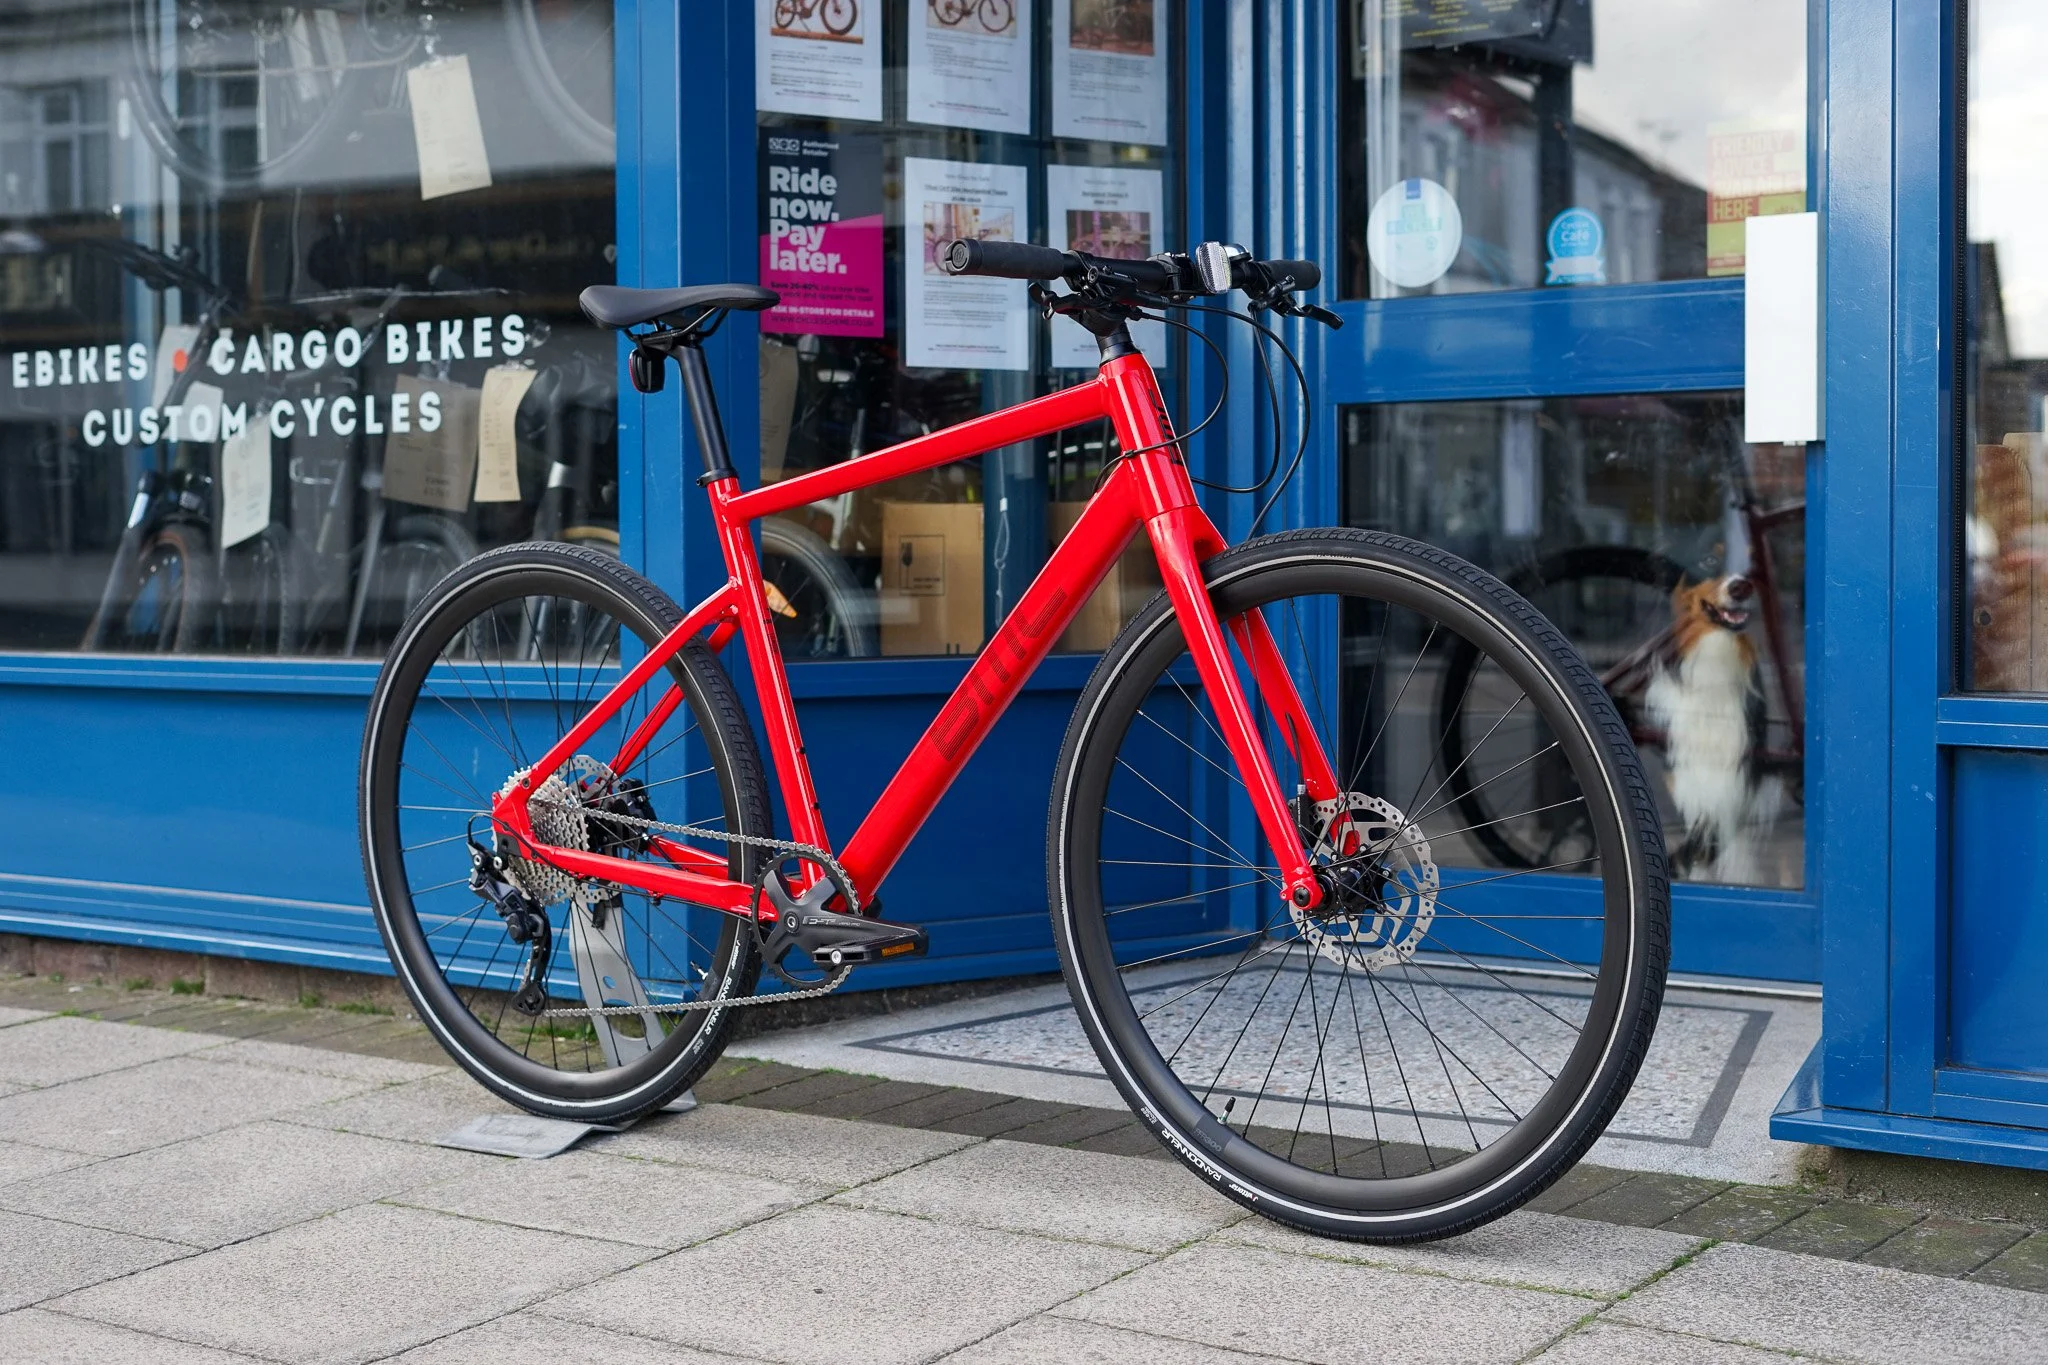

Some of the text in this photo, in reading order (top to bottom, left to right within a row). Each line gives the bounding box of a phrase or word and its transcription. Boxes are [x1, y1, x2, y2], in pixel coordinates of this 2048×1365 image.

[769, 166, 838, 196] Ride
[769, 197, 840, 222] now.
[1713, 198, 1754, 221] HERE
[769, 219, 826, 252] Pay
[769, 242, 847, 274] later.
[825, 307, 842, 316] FOR
[842, 308, 875, 318] DETAILS
[211, 314, 525, 376] CARGO BIKES
[12, 343, 148, 388] EBIKES
[82, 391, 442, 447] CUSTOM CYCLES
[1161, 1128, 1222, 1182] RANDONNEUR
